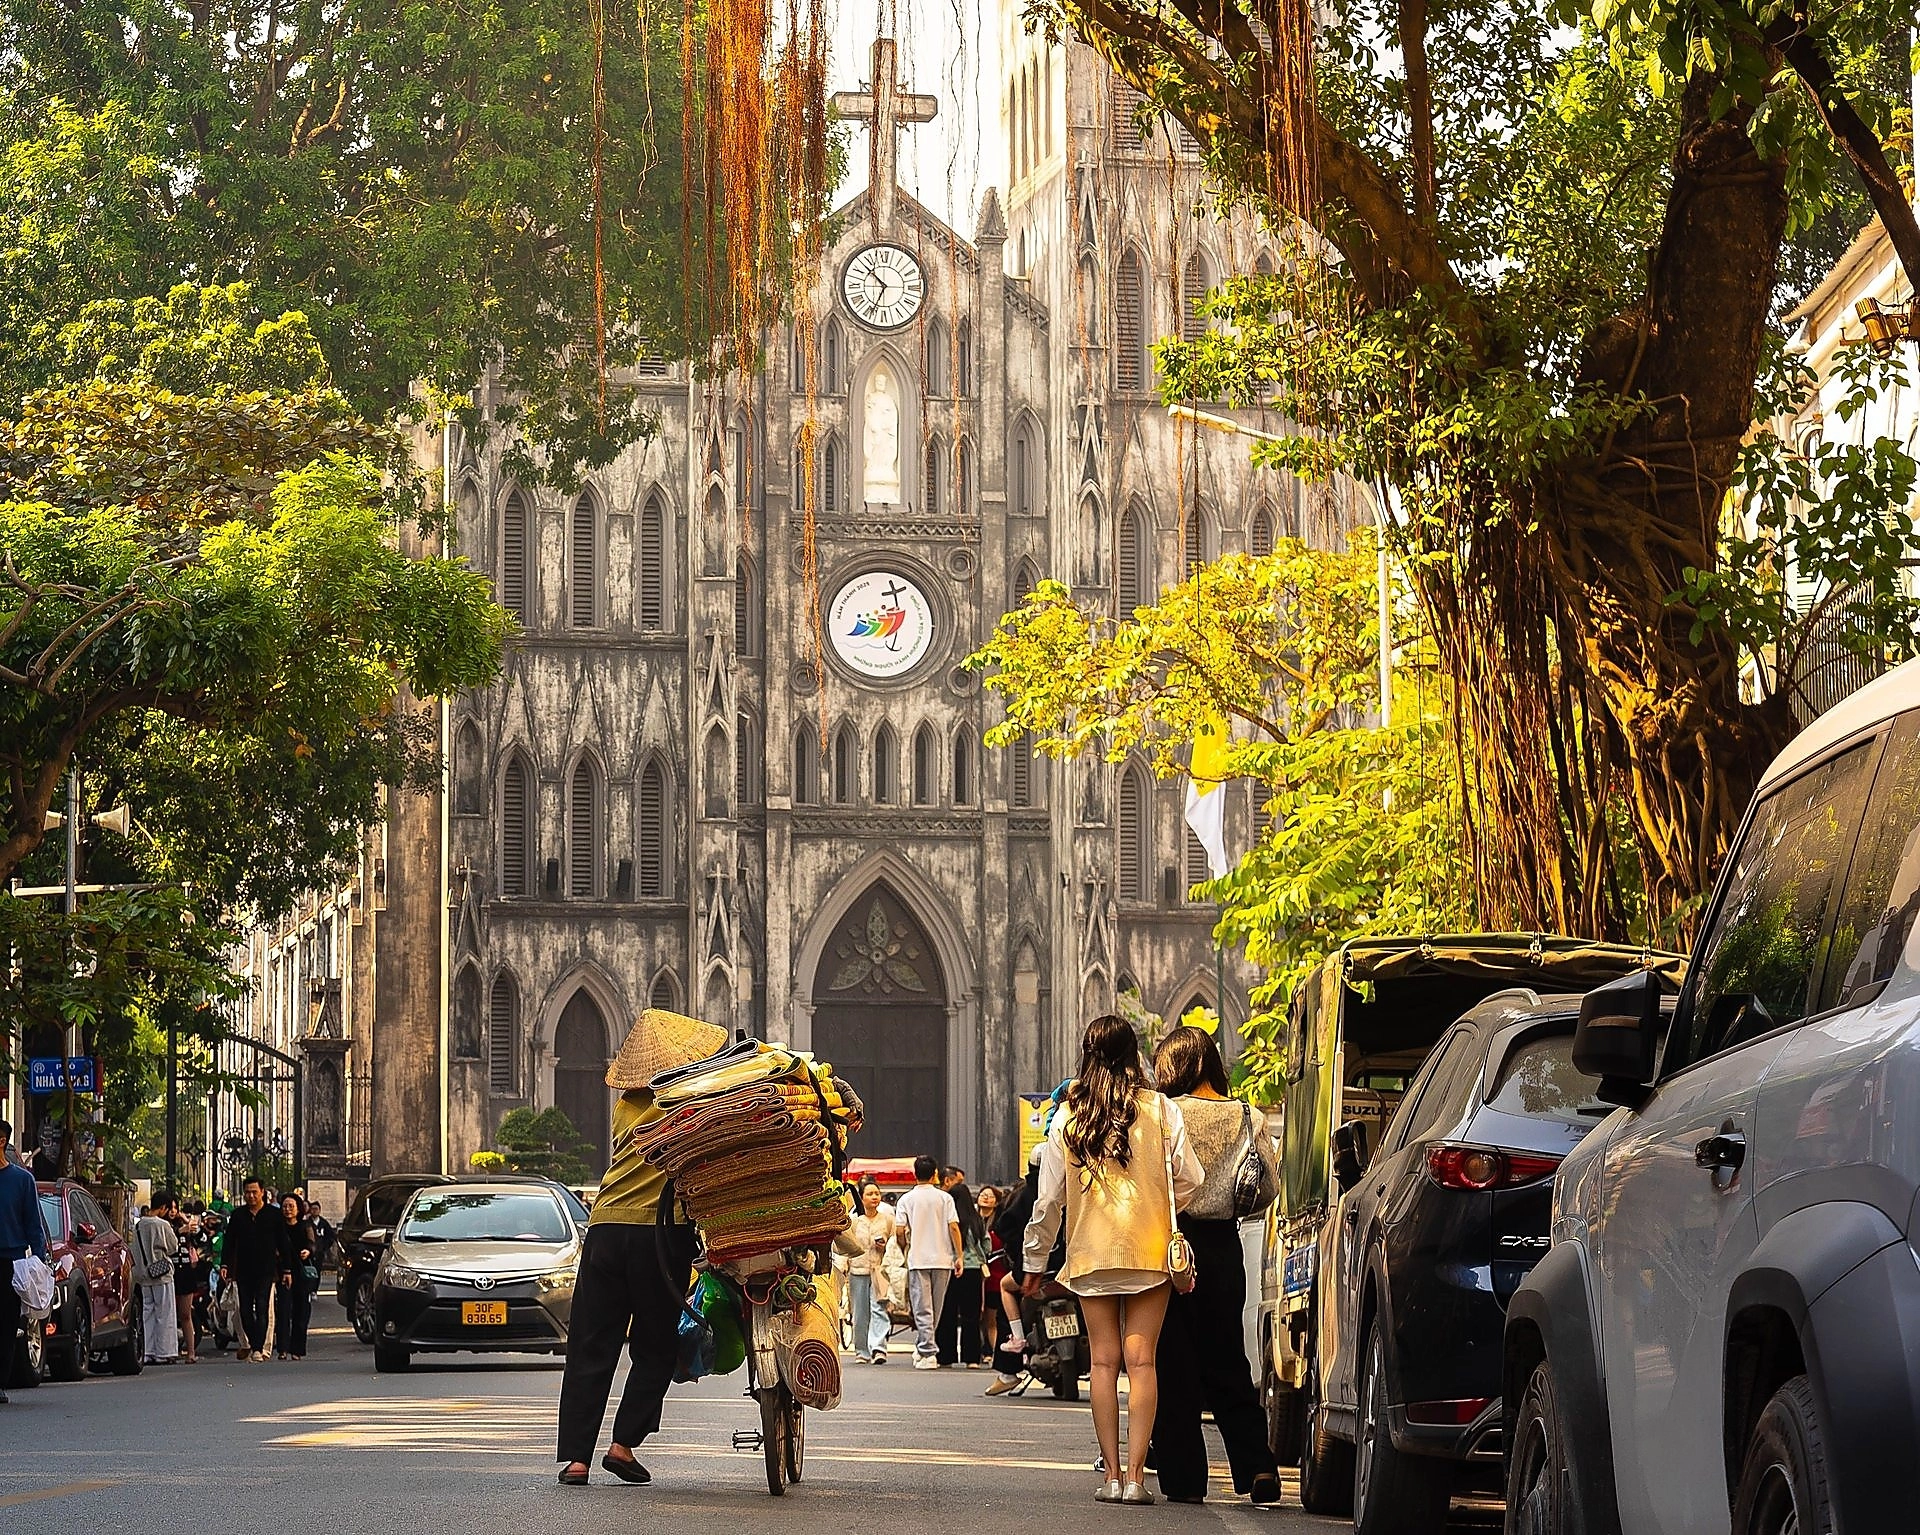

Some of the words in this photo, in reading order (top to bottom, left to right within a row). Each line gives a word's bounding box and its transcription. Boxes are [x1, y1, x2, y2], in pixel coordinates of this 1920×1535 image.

[35, 1072, 55, 1088] NHÀ
[1499, 1235, 1551, 1247] CX-5
[475, 1303, 494, 1313] 30F
[466, 1313, 502, 1324] 838.65
[1048, 1324, 1077, 1338] 920.08
